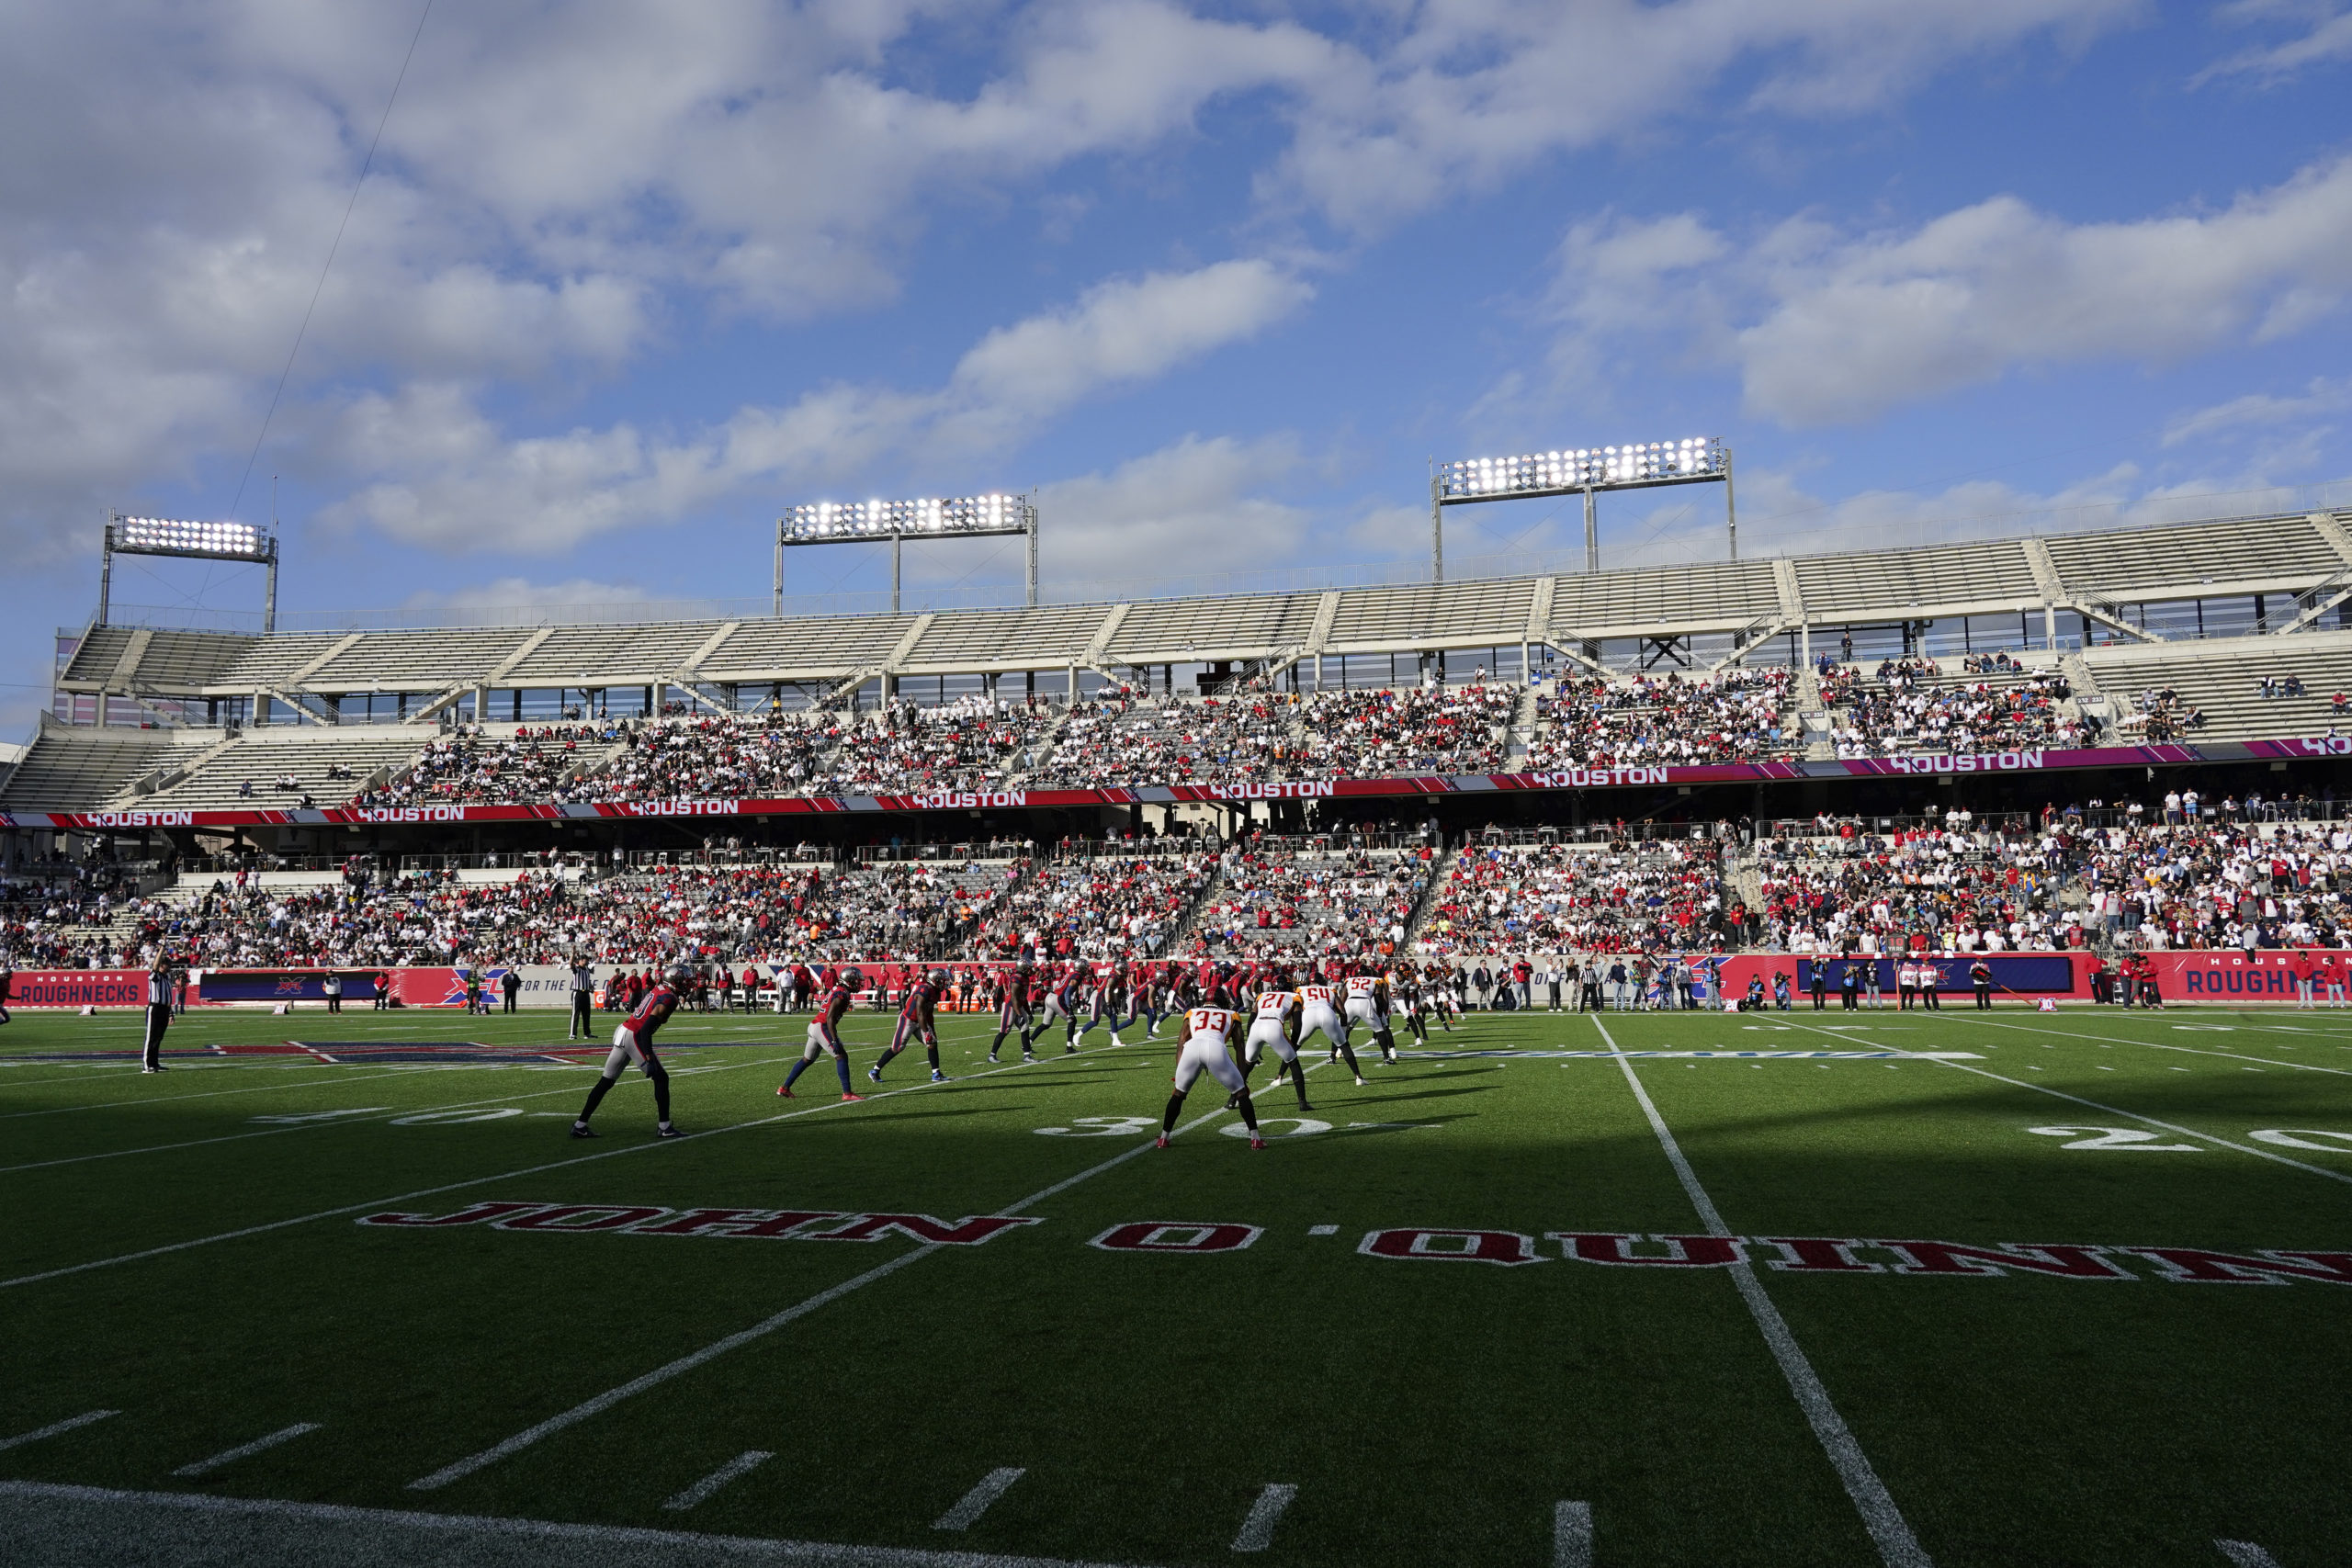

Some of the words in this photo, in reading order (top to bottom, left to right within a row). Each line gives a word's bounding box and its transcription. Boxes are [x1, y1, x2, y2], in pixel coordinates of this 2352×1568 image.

[1889, 937, 1904, 947] 10
[517, 980, 539, 991] FOR
[545, 979, 564, 991] THE
[1351, 978, 1371, 991] 52
[20, 985, 138, 1002] ROUGHNECKS
[595, 994, 605, 1004] G
[1261, 993, 1285, 1009] 21
[1307, 987, 1330, 1002] 54
[1194, 1010, 1227, 1033] 33
[354, 1201, 1046, 1246] JOHN
